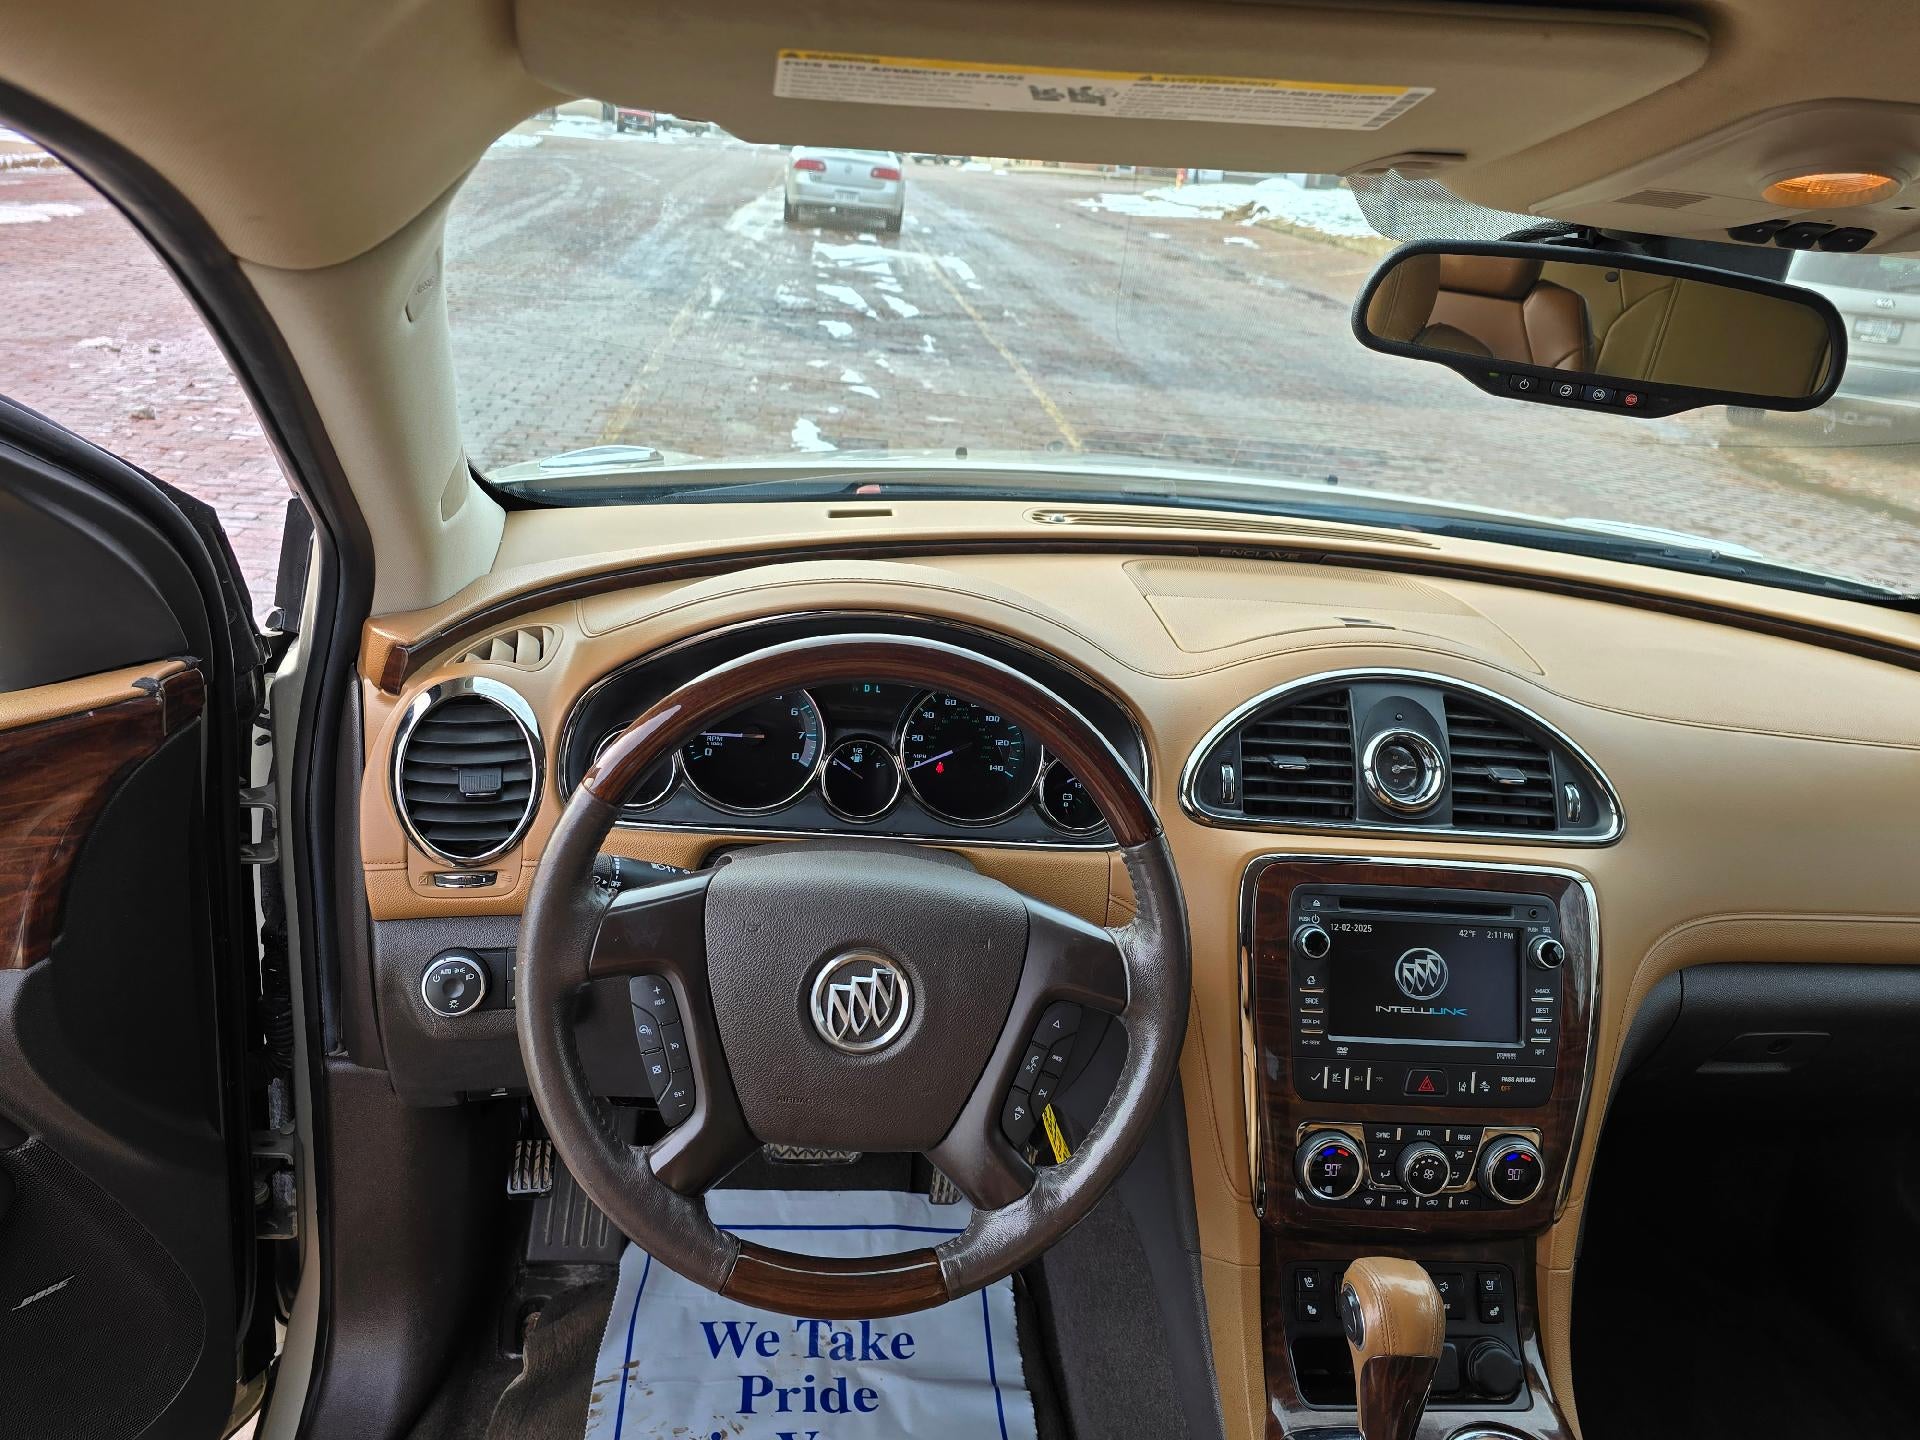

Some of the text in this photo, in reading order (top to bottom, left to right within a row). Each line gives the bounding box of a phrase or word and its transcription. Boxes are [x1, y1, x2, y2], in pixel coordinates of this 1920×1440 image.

[791, 707, 799, 716] 6
[798, 731, 806, 739] 7
[1330, 923, 1373, 933] 12-02-2025
[1487, 930, 1502, 939] 2:11
[1375, 1131, 1391, 1139] SYNC
[700, 1319, 916, 1361] We Take
[736, 1374, 880, 1414] Pride
